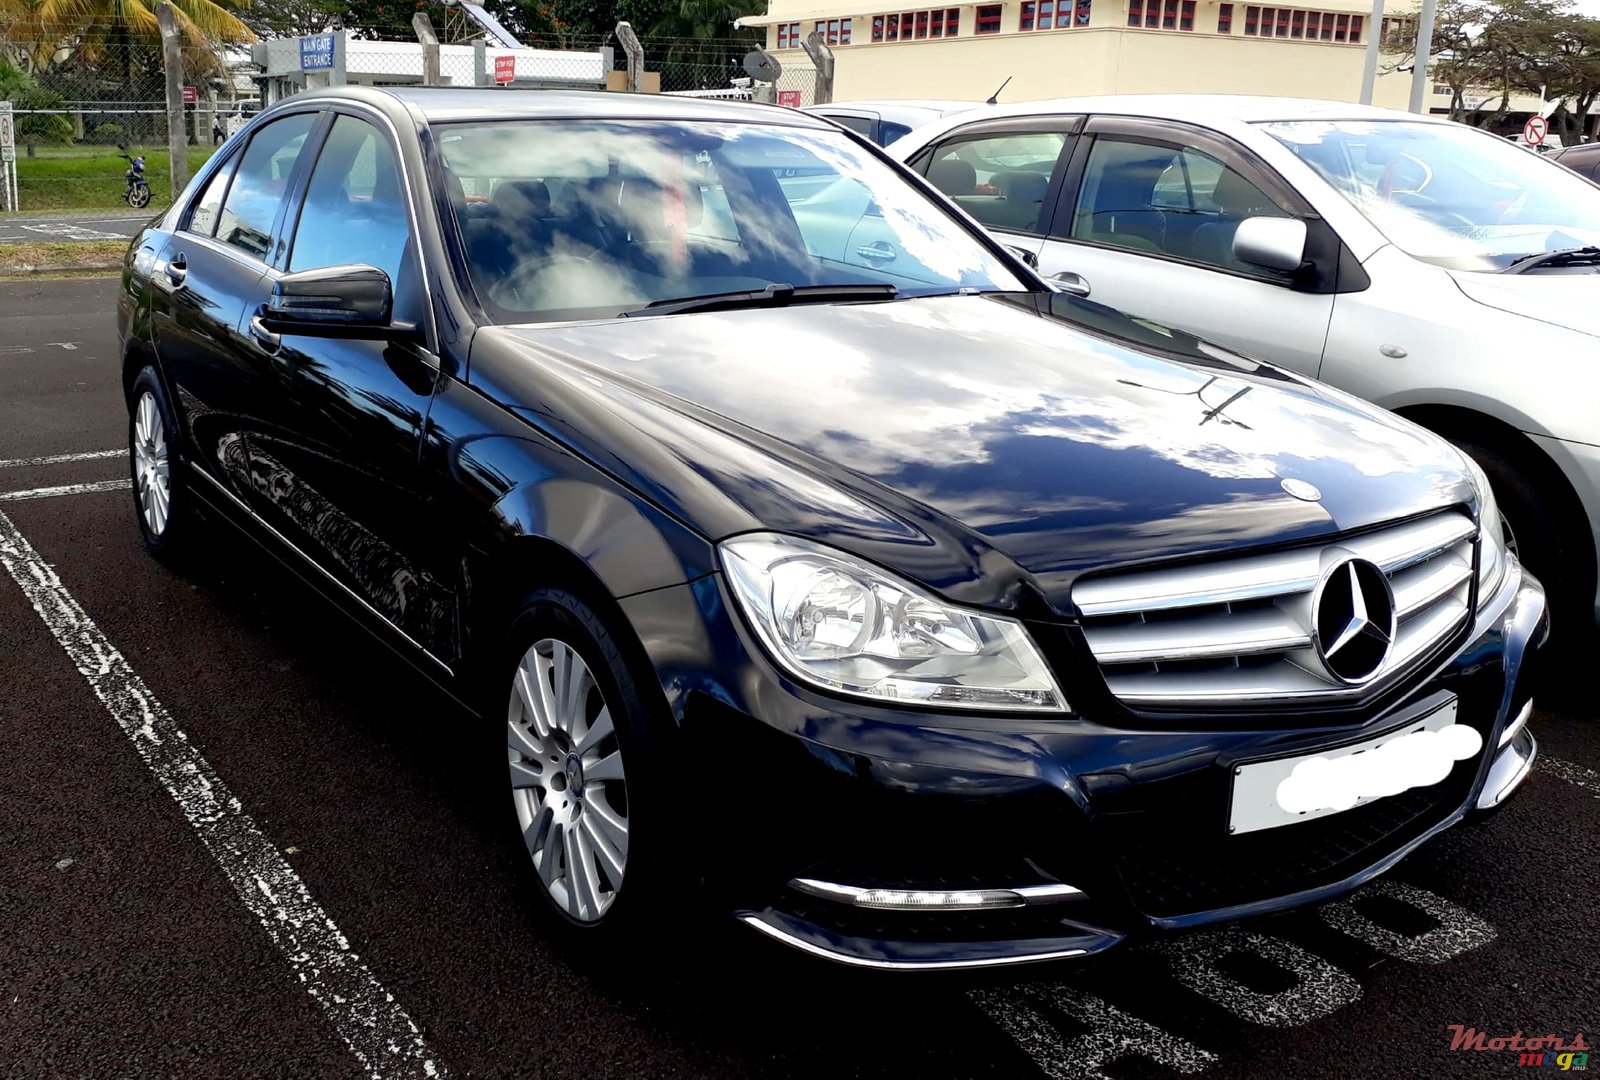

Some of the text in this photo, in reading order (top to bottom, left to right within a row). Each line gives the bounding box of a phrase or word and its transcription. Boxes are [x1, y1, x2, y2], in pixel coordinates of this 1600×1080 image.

[303, 37, 331, 51] MAIN GATE
[304, 53, 331, 67] ENTRANCE
[783, 92, 795, 100] STOP
